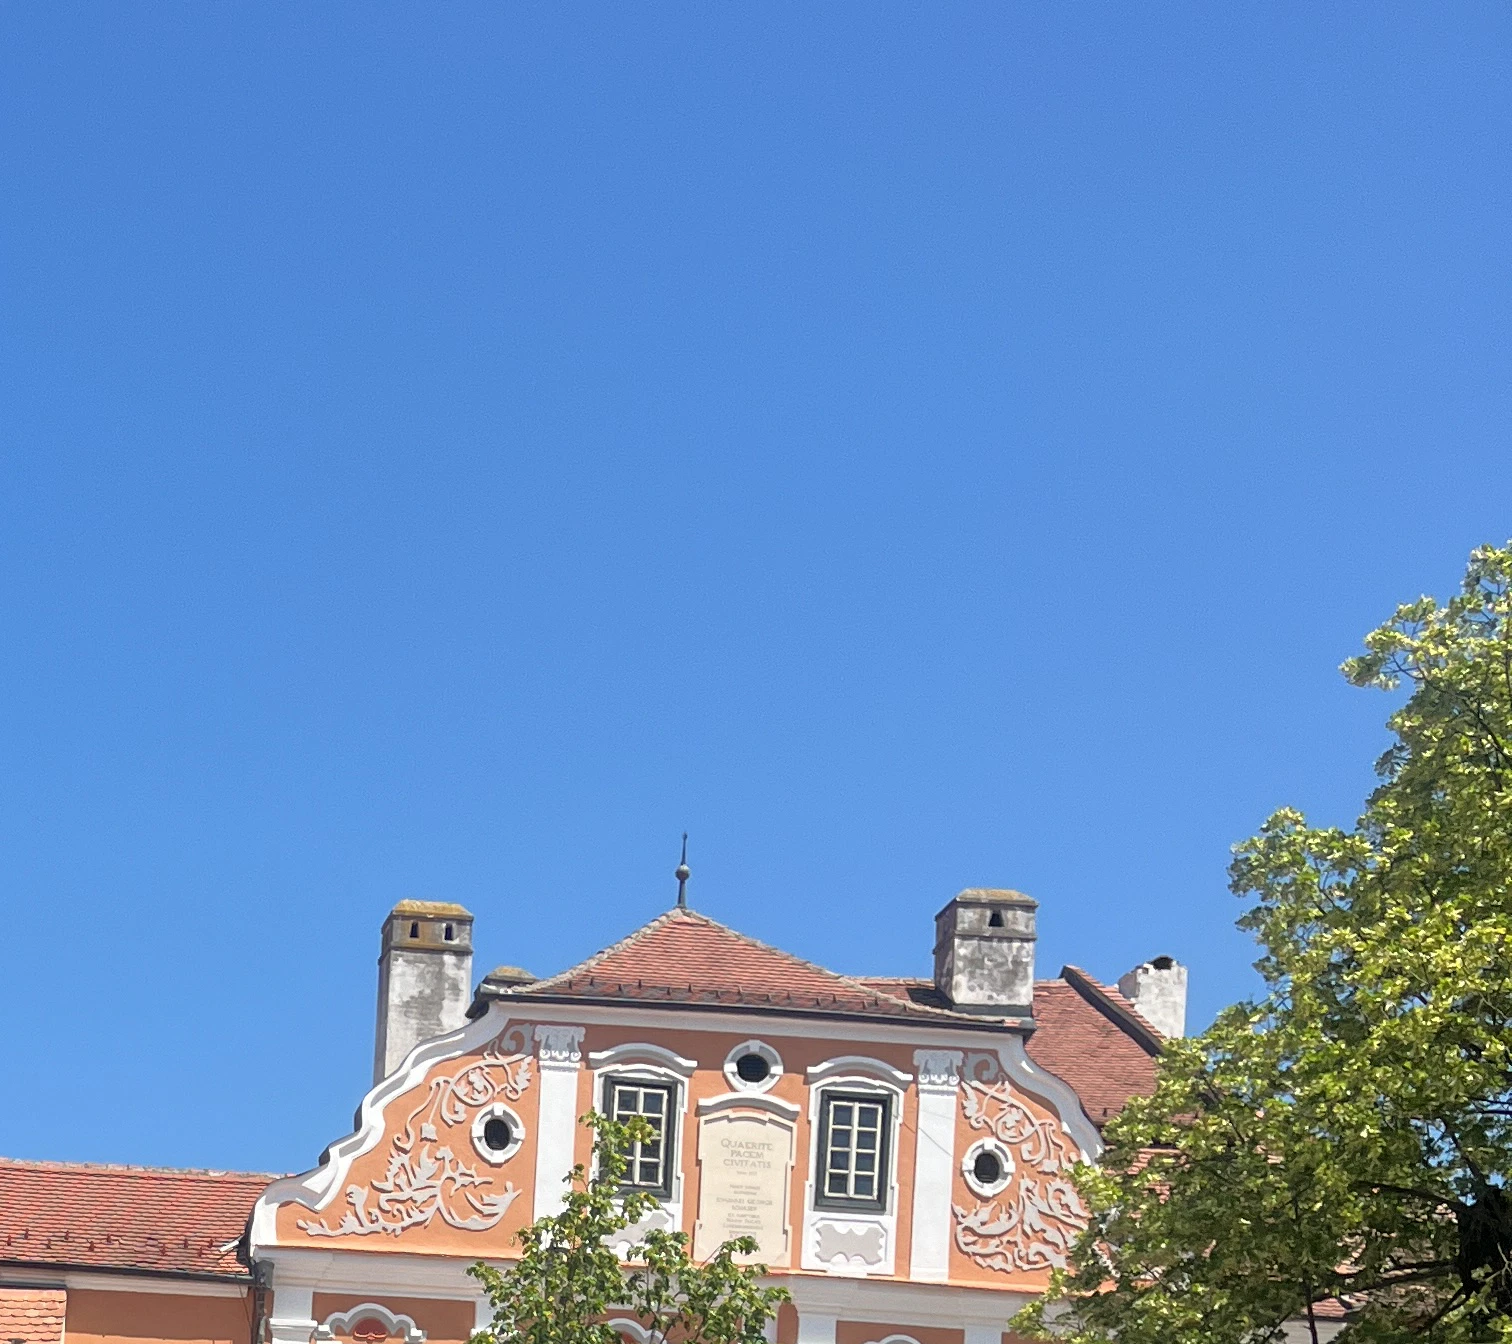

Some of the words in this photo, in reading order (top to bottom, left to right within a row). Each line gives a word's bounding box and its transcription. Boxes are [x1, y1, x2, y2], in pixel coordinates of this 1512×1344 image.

[721, 1138, 773, 1150] QUAERITE
[730, 1150, 764, 1158] PACEM
[723, 1159, 771, 1168] CIVITATIS
